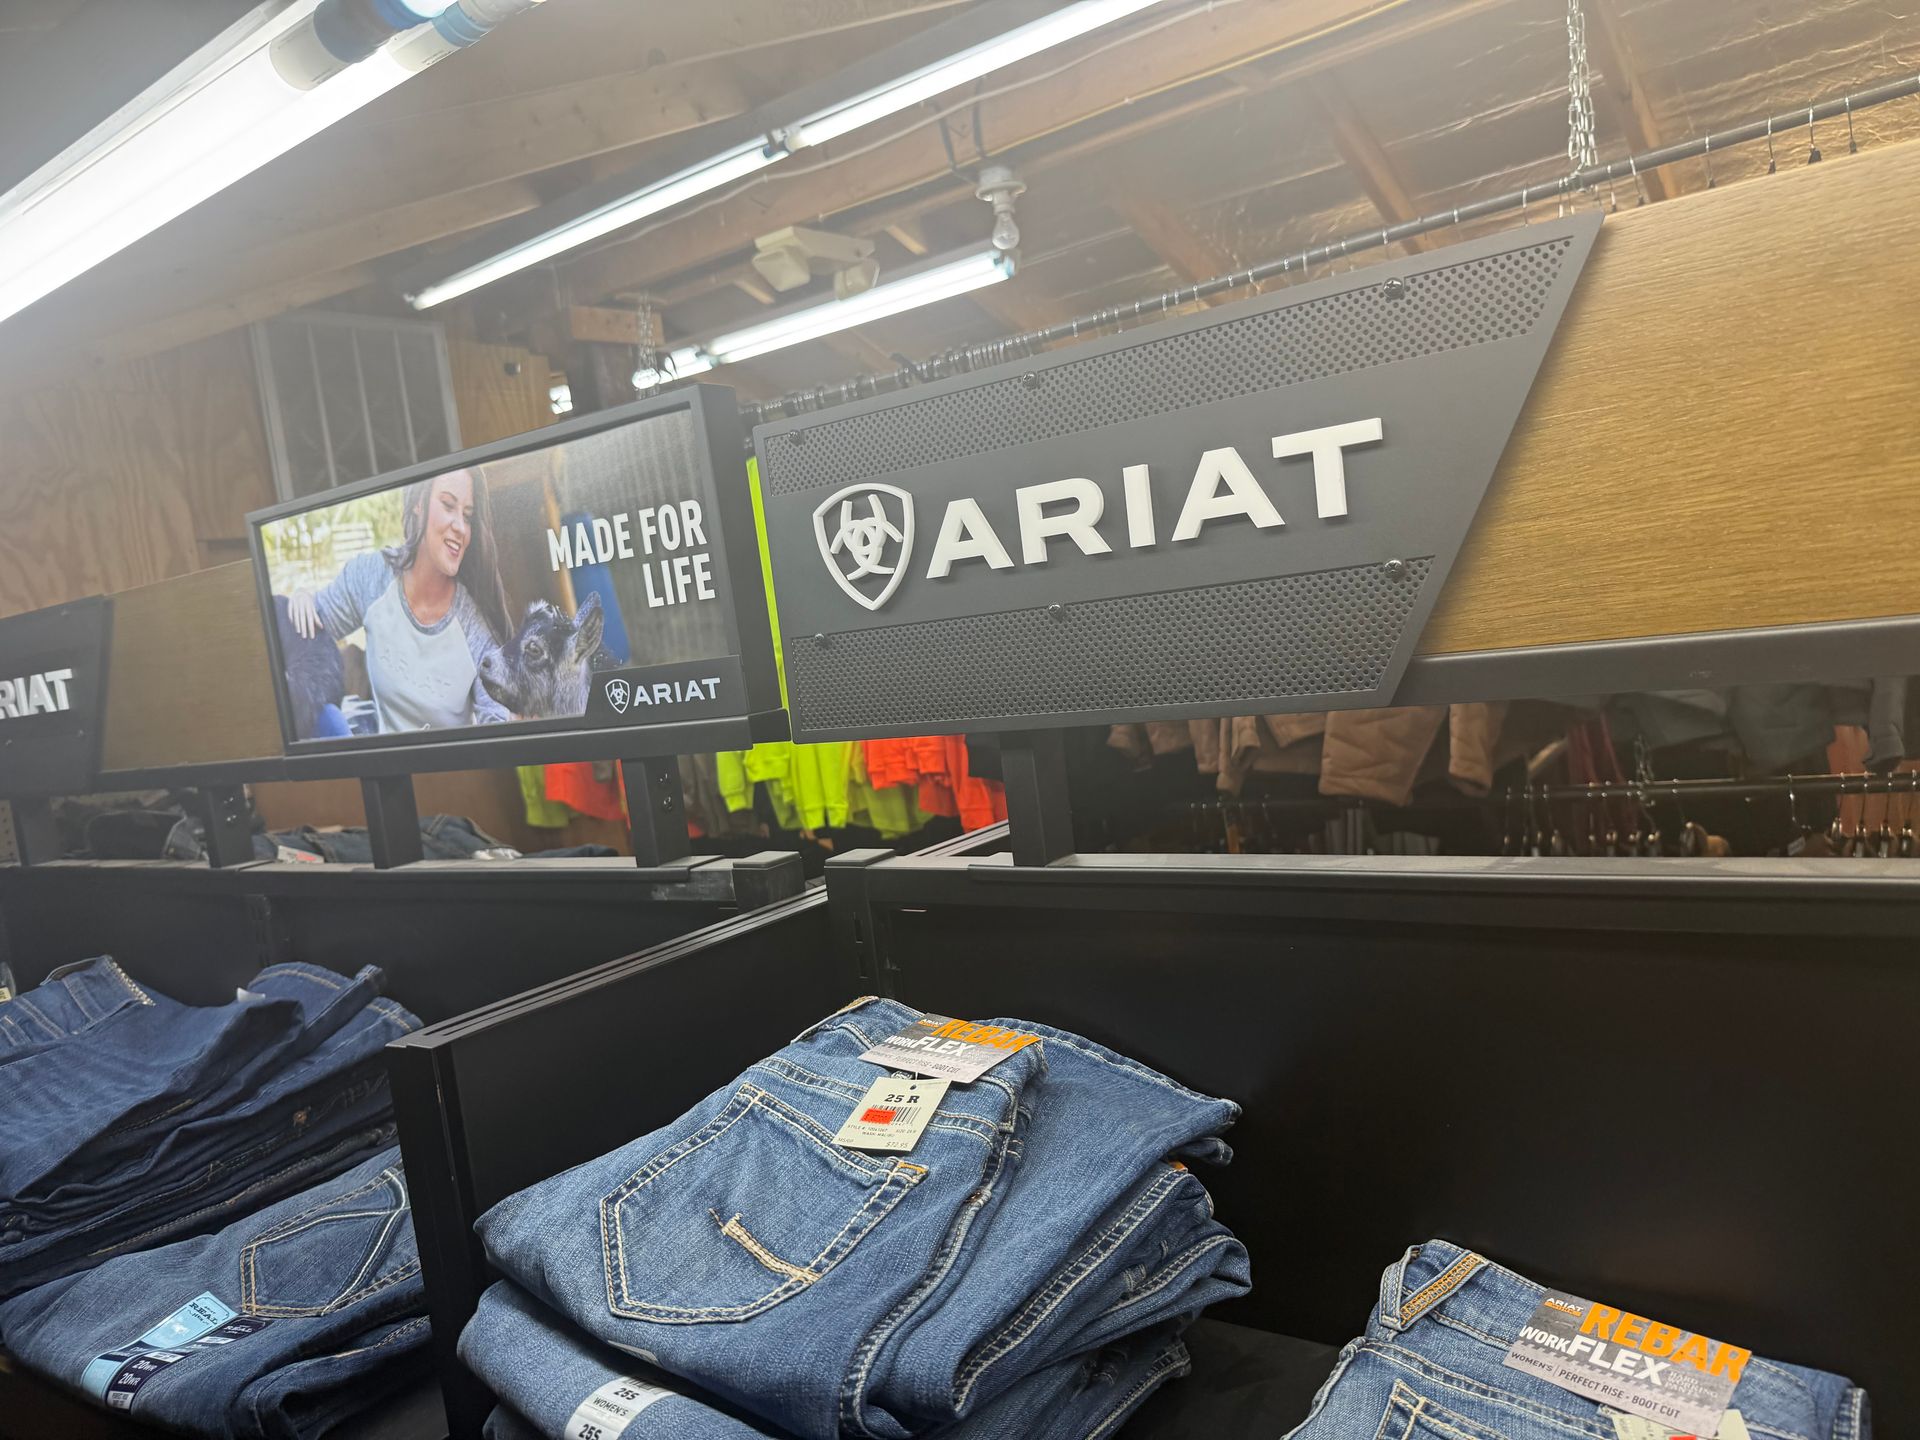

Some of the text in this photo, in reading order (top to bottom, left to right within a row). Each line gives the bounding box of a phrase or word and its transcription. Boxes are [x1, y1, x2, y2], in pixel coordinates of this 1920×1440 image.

[926, 417, 1383, 579] ARIAT
[547, 499, 708, 571] MADE FOR
[642, 553, 716, 608] LIFE
[633, 677, 721, 707] ARIAT
[931, 1018, 1042, 1052] REBAR
[884, 1093, 920, 1104] 25 R
[189, 1301, 218, 1325] REAL
[1546, 1297, 1584, 1312] ARIAT
[1579, 1302, 1752, 1384] REBAR
[613, 1387, 640, 1401] 25S
[1511, 1350, 1681, 1418] WOMEN'S PERFECT RISE BOOT CUT
[593, 1397, 629, 1417] WOMEN'S
